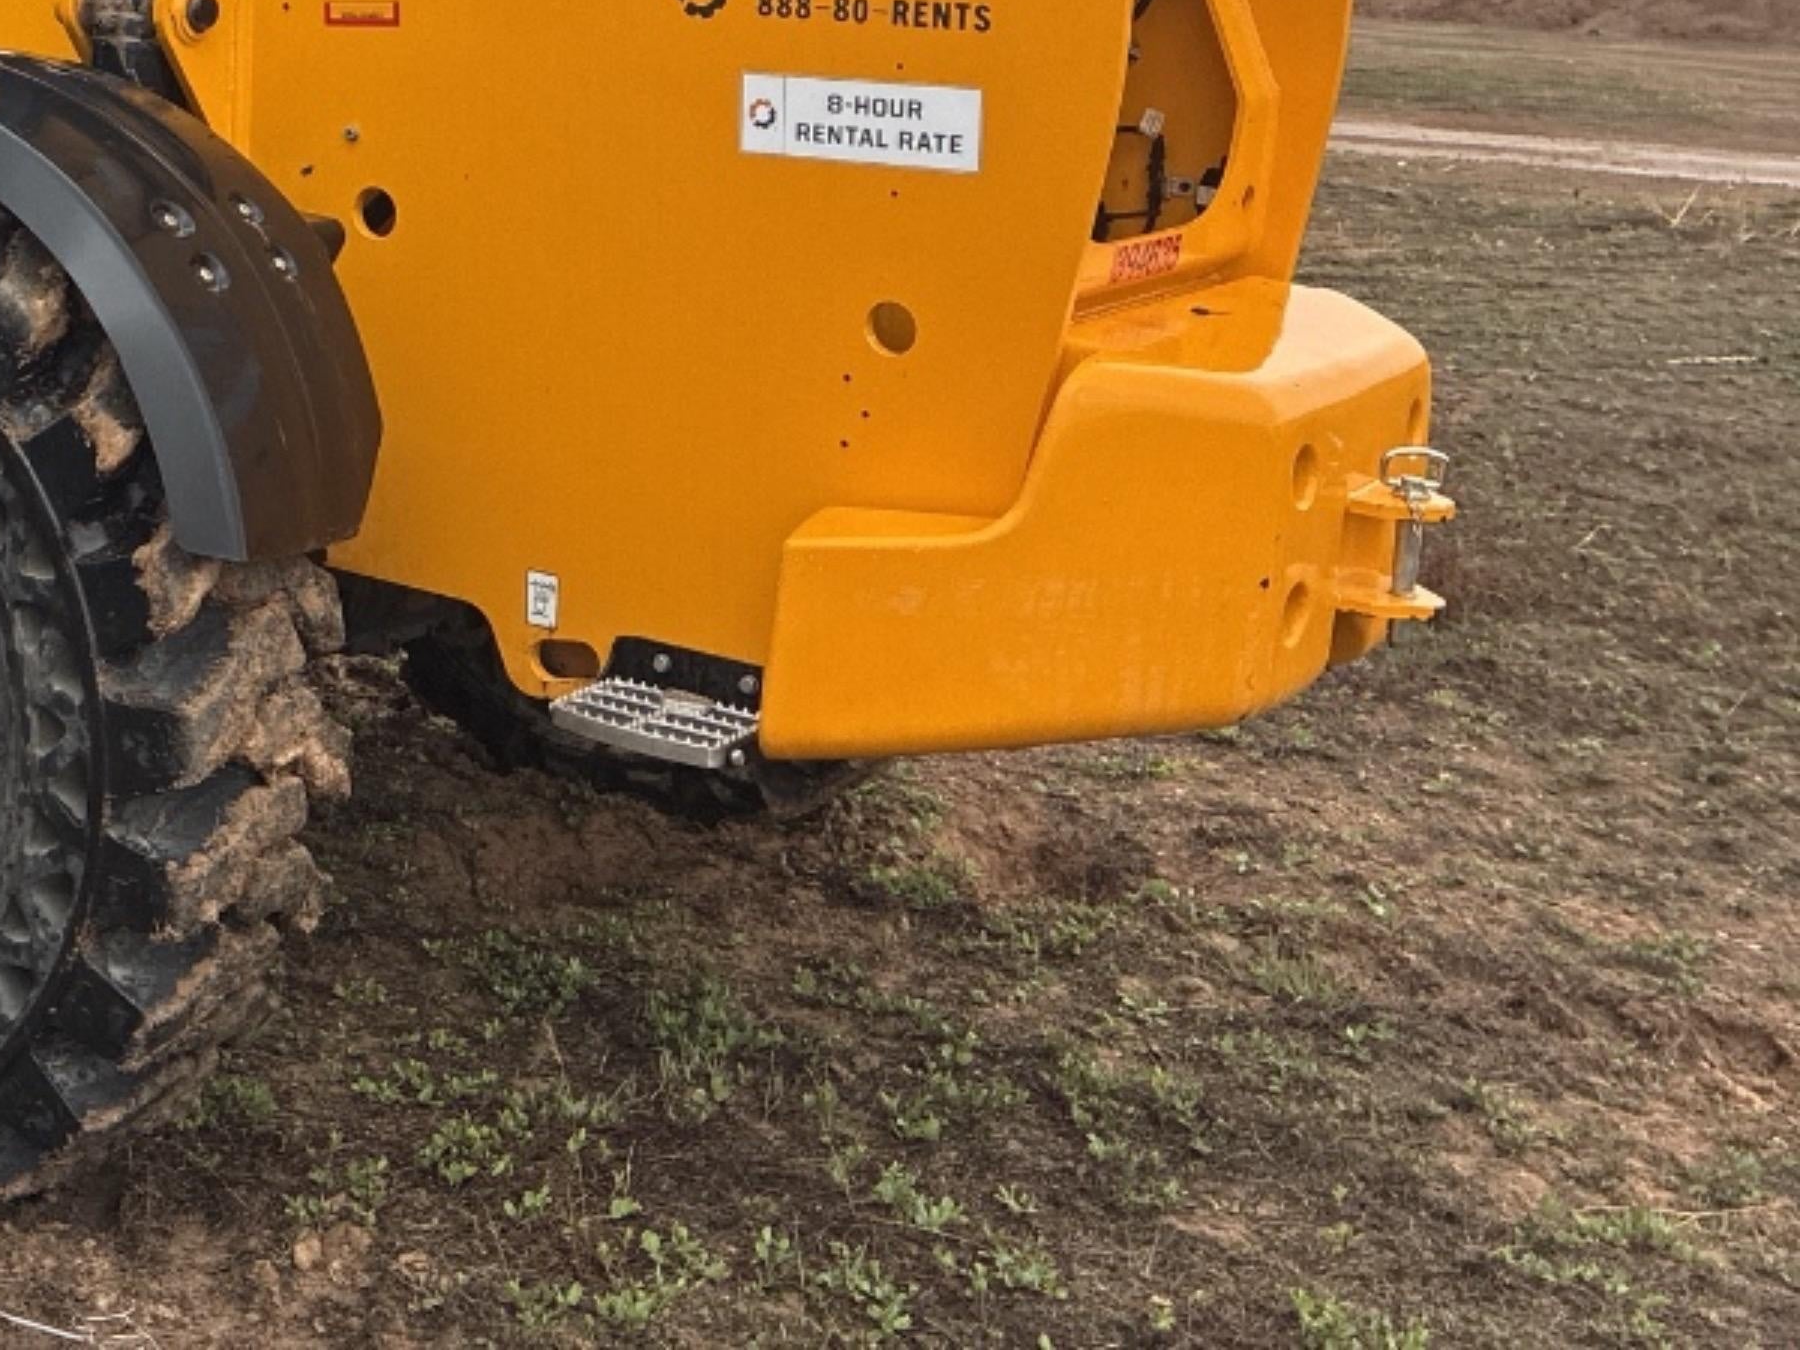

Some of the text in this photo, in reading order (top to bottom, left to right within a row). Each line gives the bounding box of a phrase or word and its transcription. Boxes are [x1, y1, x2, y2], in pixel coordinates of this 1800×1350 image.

[827, 94, 924, 120] 8-HOUR
[795, 123, 964, 155] RENTAL RATE
